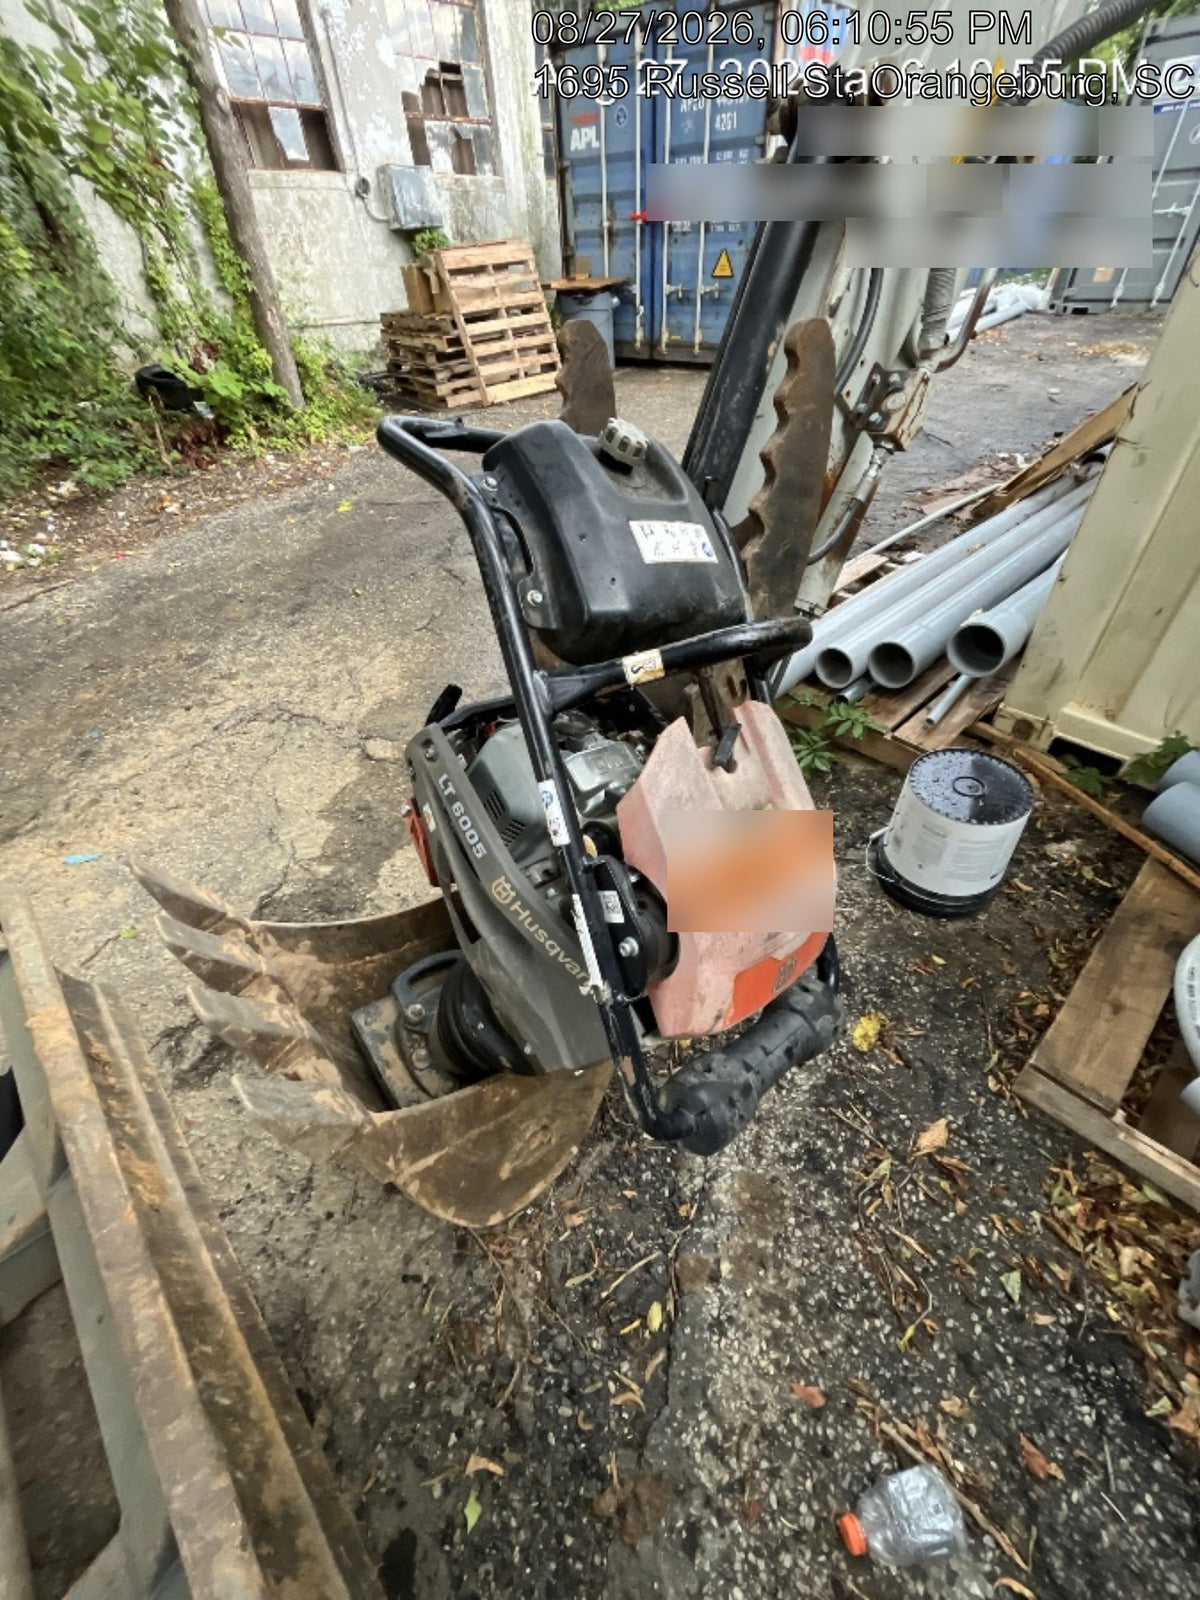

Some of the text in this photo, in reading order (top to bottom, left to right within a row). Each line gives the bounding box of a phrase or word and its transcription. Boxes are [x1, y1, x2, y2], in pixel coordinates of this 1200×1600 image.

[570, 125, 600, 151] APL
[438, 773, 488, 859] LT 6005
